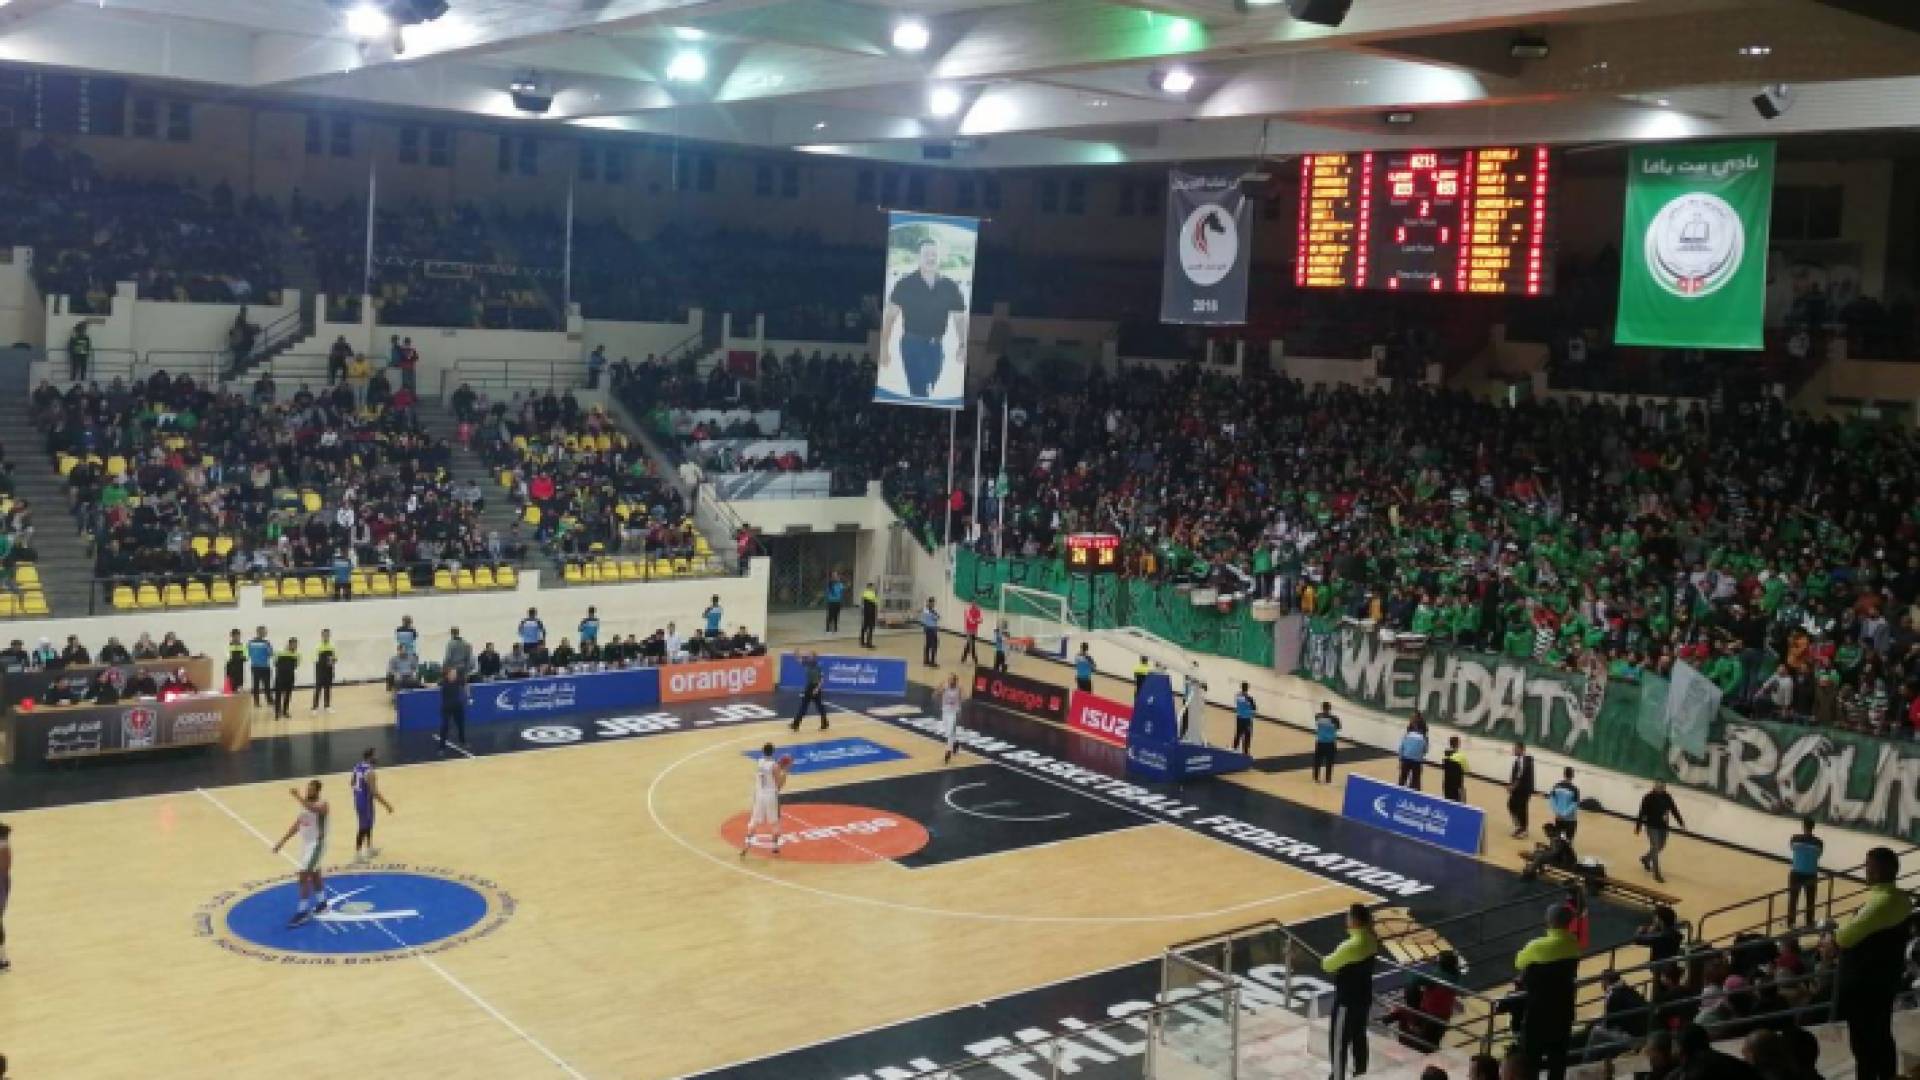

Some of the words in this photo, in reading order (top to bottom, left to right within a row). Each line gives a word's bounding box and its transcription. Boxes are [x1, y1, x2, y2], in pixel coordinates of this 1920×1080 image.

[670, 664, 757, 693] orange
[1080, 706, 1129, 738] ISUZ
[1193, 814, 1435, 896] FEDERATION
